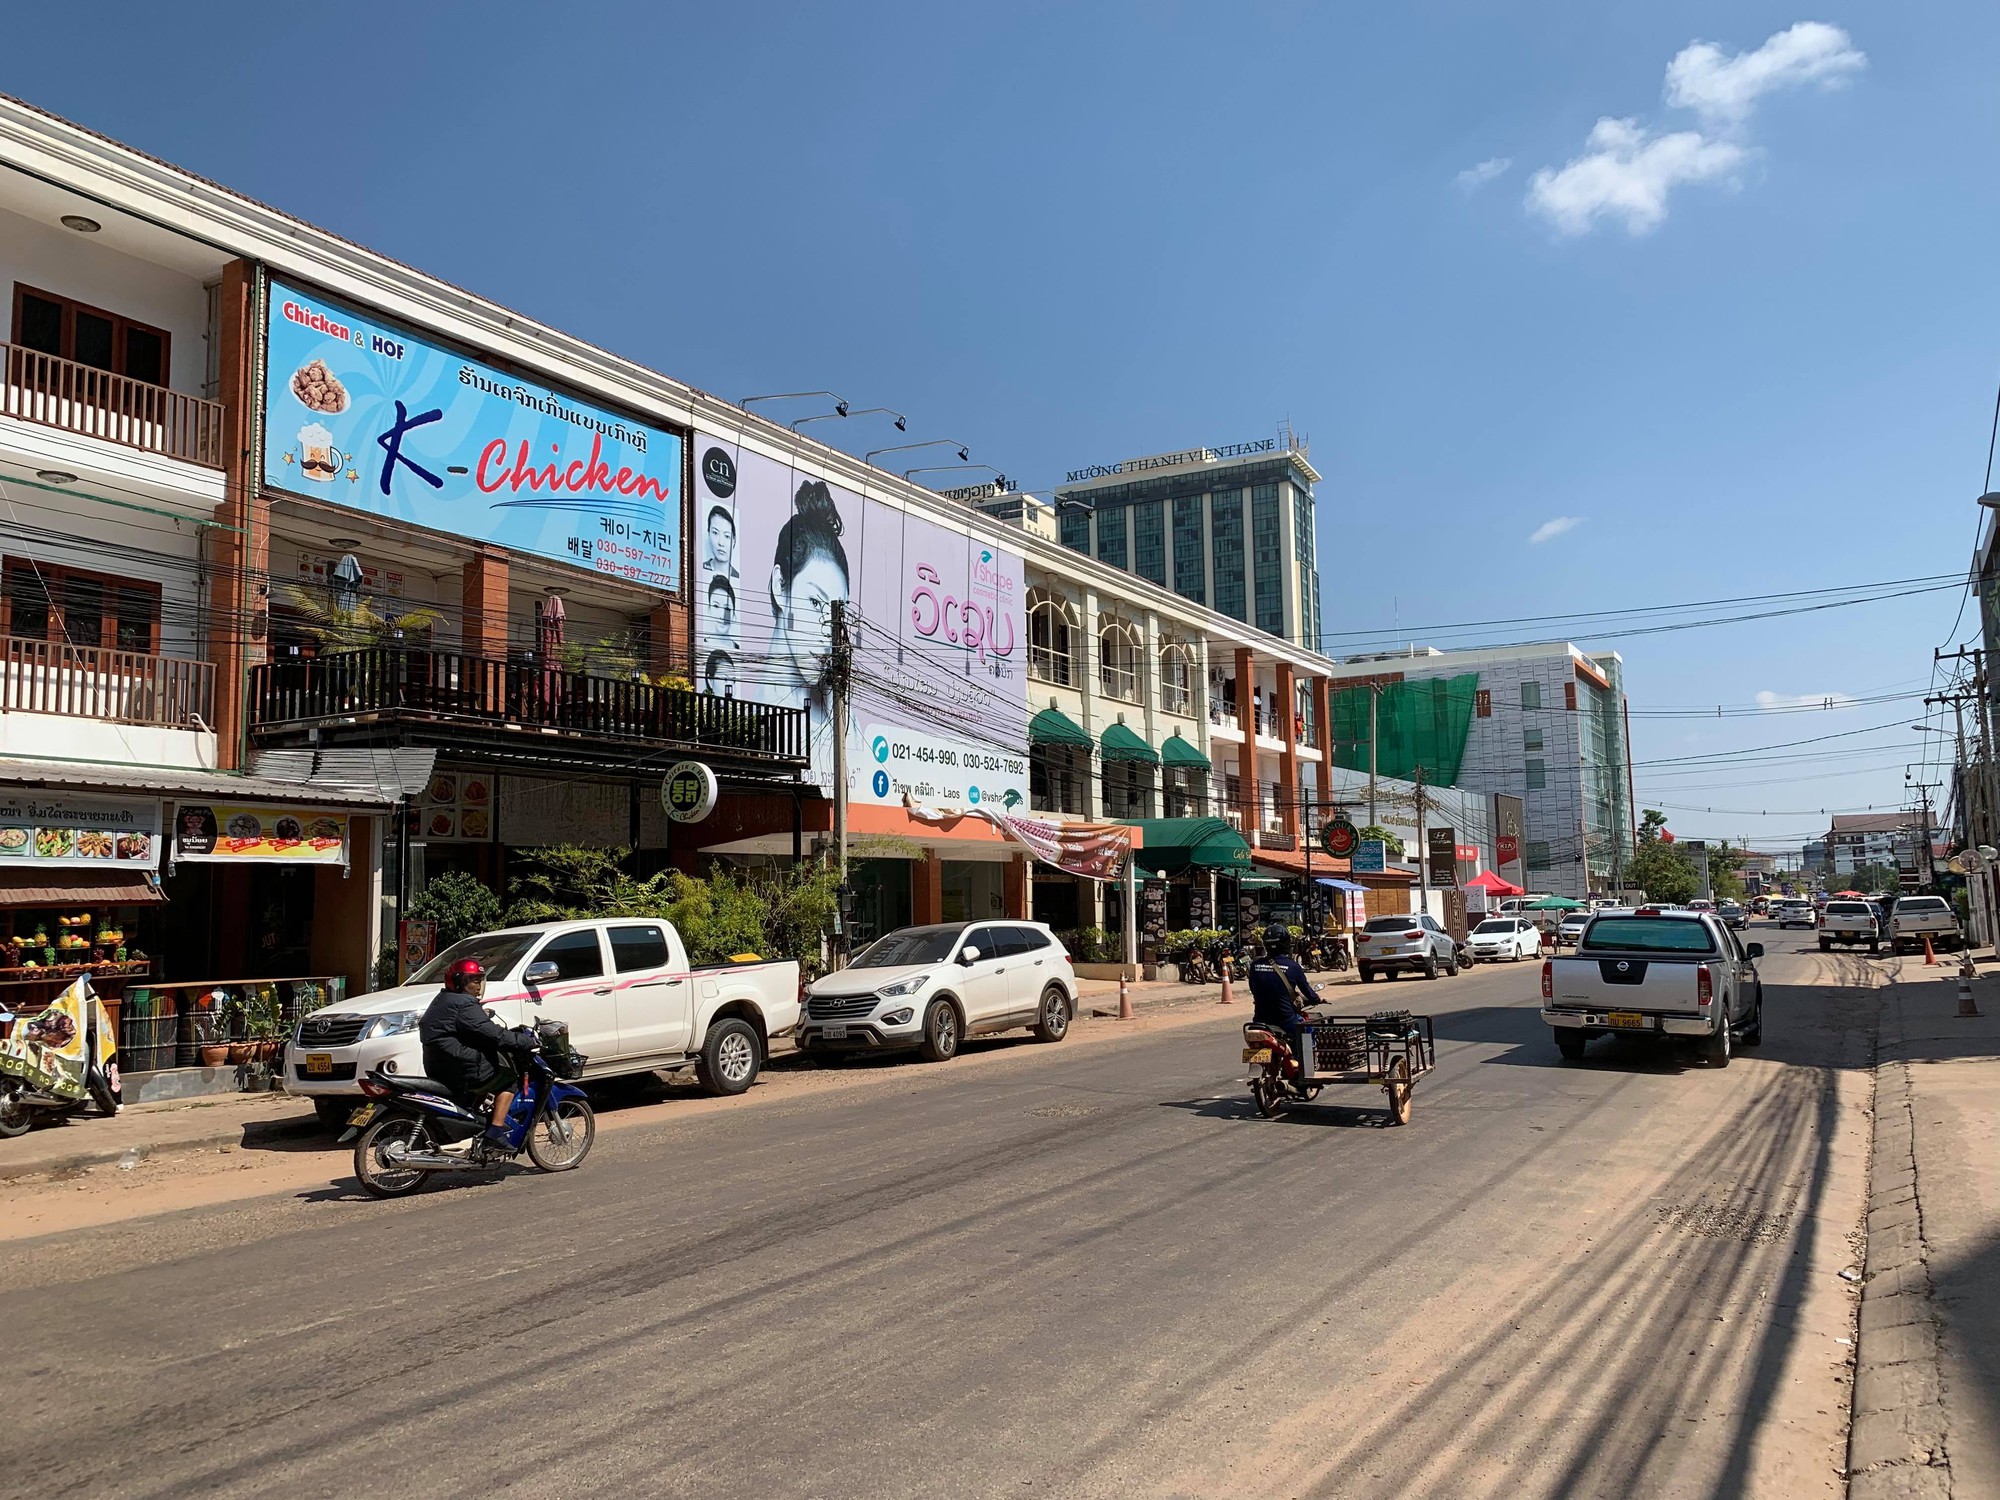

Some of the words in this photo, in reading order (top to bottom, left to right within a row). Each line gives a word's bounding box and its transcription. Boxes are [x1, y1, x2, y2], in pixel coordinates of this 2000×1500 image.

[283, 302, 350, 341] Chicken
[354, 332, 364, 347] &
[372, 335, 405, 360] HOF
[1065, 463, 1123, 482] MƯỜNG
[1127, 454, 1184, 472] THANH
[1188, 439, 1275, 462] VIENTIANE
[600, 517, 671, 553] 케이-치킨
[567, 537, 593, 559] 배달
[597, 539, 671, 569] 030-597-7171
[596, 557, 671, 587] 030-597-7272
[892, 743, 959, 768] 021-454-990,
[963, 753, 1024, 775] 030-524-7692
[943, 786, 960, 800] Laos
[1324, 822, 1351, 837] SINOUK
[1622, 1018, 1641, 1027] 9665
